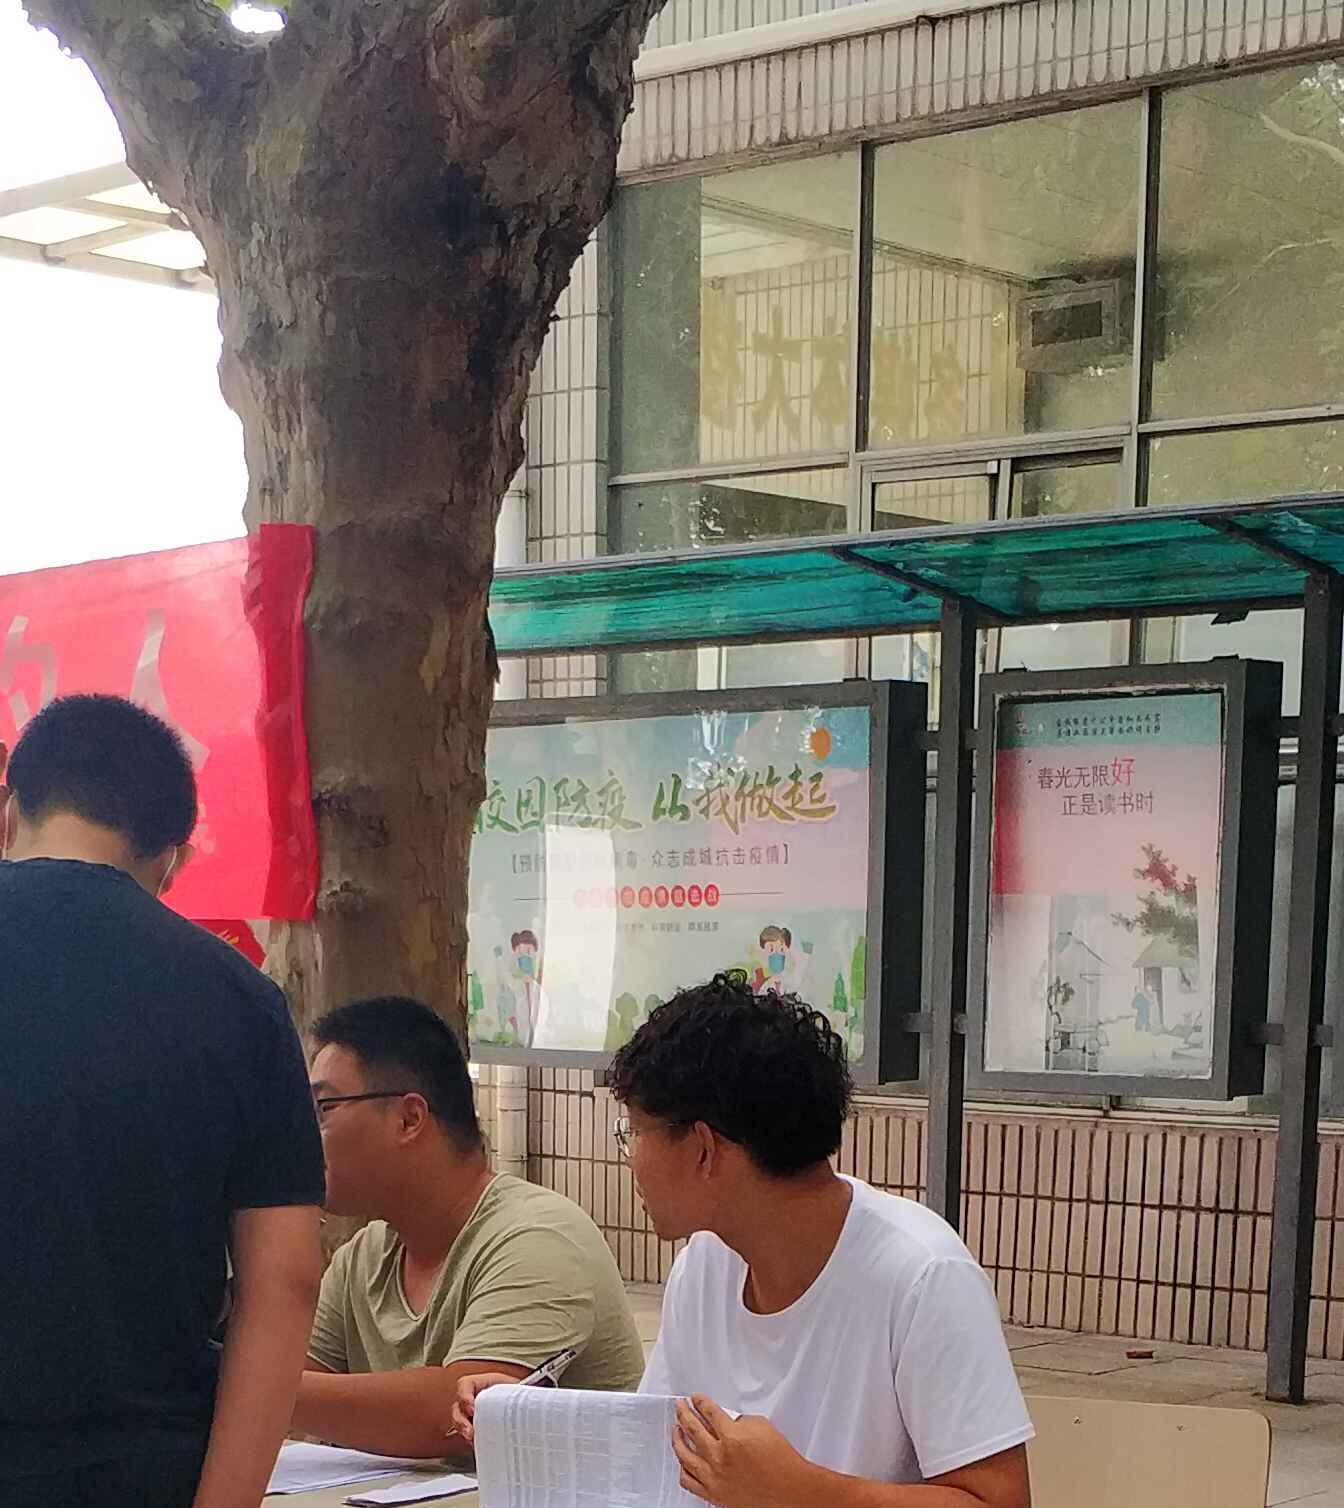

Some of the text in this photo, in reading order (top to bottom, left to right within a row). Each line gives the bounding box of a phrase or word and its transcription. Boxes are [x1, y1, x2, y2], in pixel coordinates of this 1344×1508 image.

[1038, 756, 1135, 790] 春光无限好
[1061, 790, 1155, 816] 正是读书时
